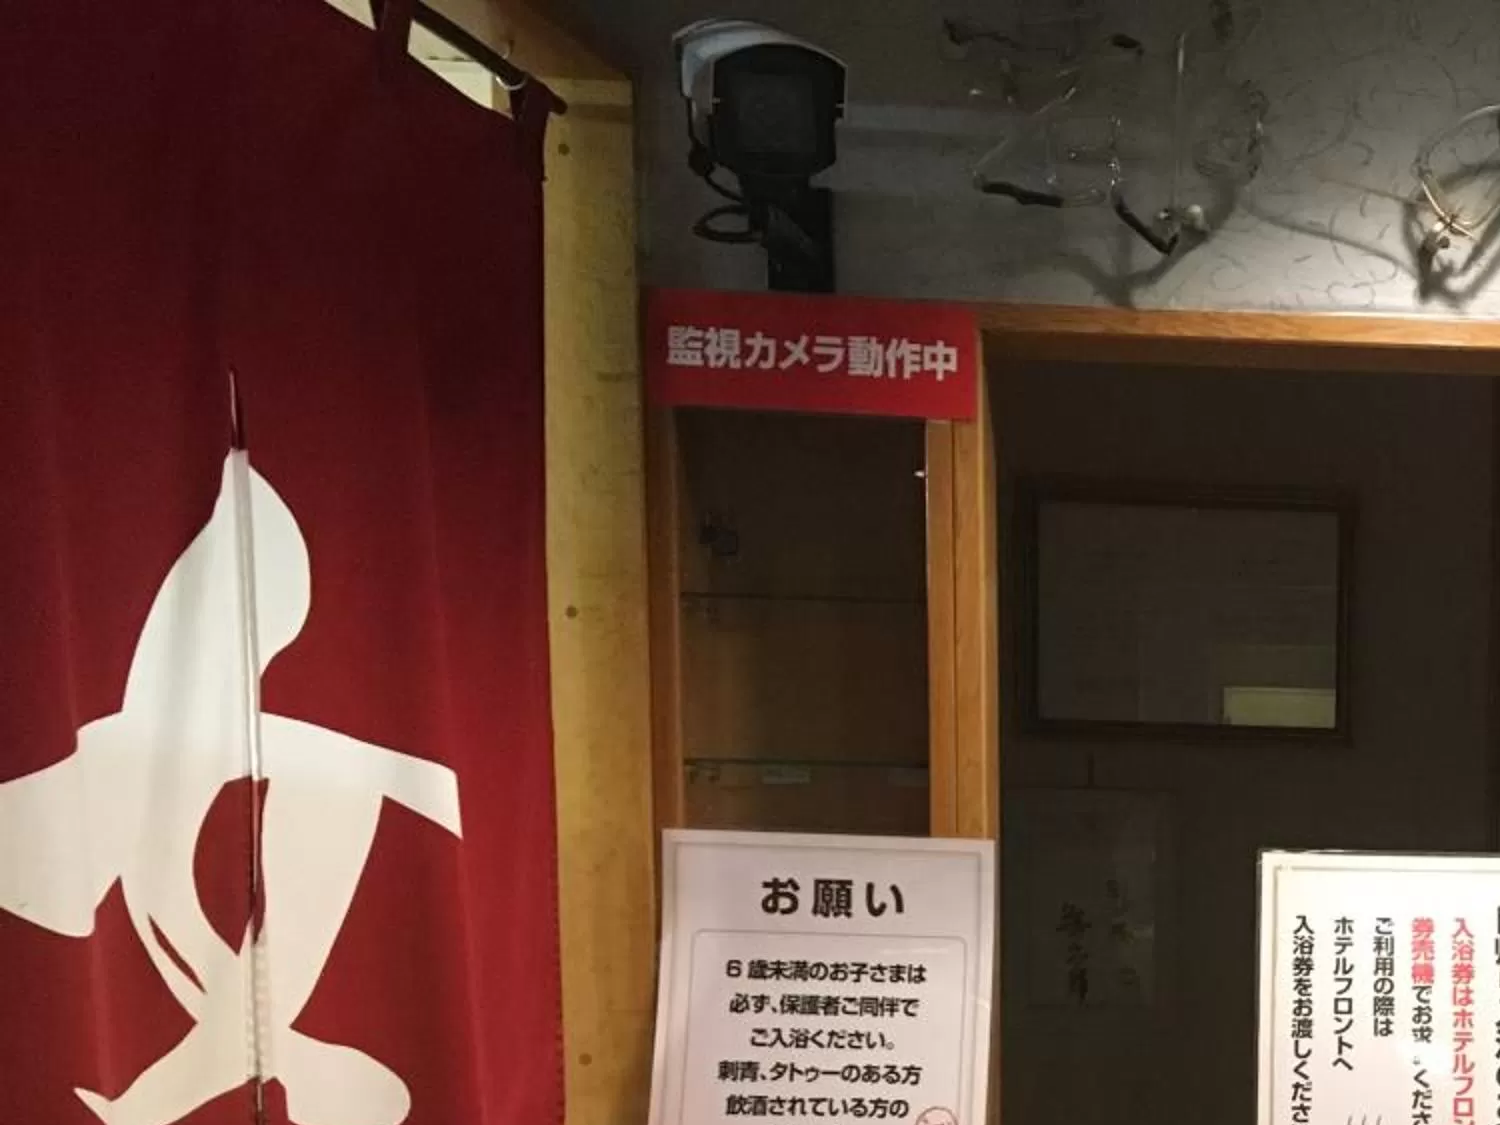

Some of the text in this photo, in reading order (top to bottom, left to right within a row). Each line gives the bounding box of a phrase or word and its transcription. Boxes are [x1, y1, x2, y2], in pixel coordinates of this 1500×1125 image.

[666, 326, 958, 381] 監視カメラ動作中
[761, 878, 905, 919] お願い
[1373, 917, 1395, 1037] ご利用の際は
[729, 993, 920, 1017] 必ず、保護者ご同伴で
[1332, 917, 1354, 1071] ホテルフロントへ
[751, 1028, 895, 1050] ご入浴ください。
[718, 1061, 923, 1085] 刺青、タトゥーのある方
[725, 1095, 910, 1118] 飲酒されている方の
